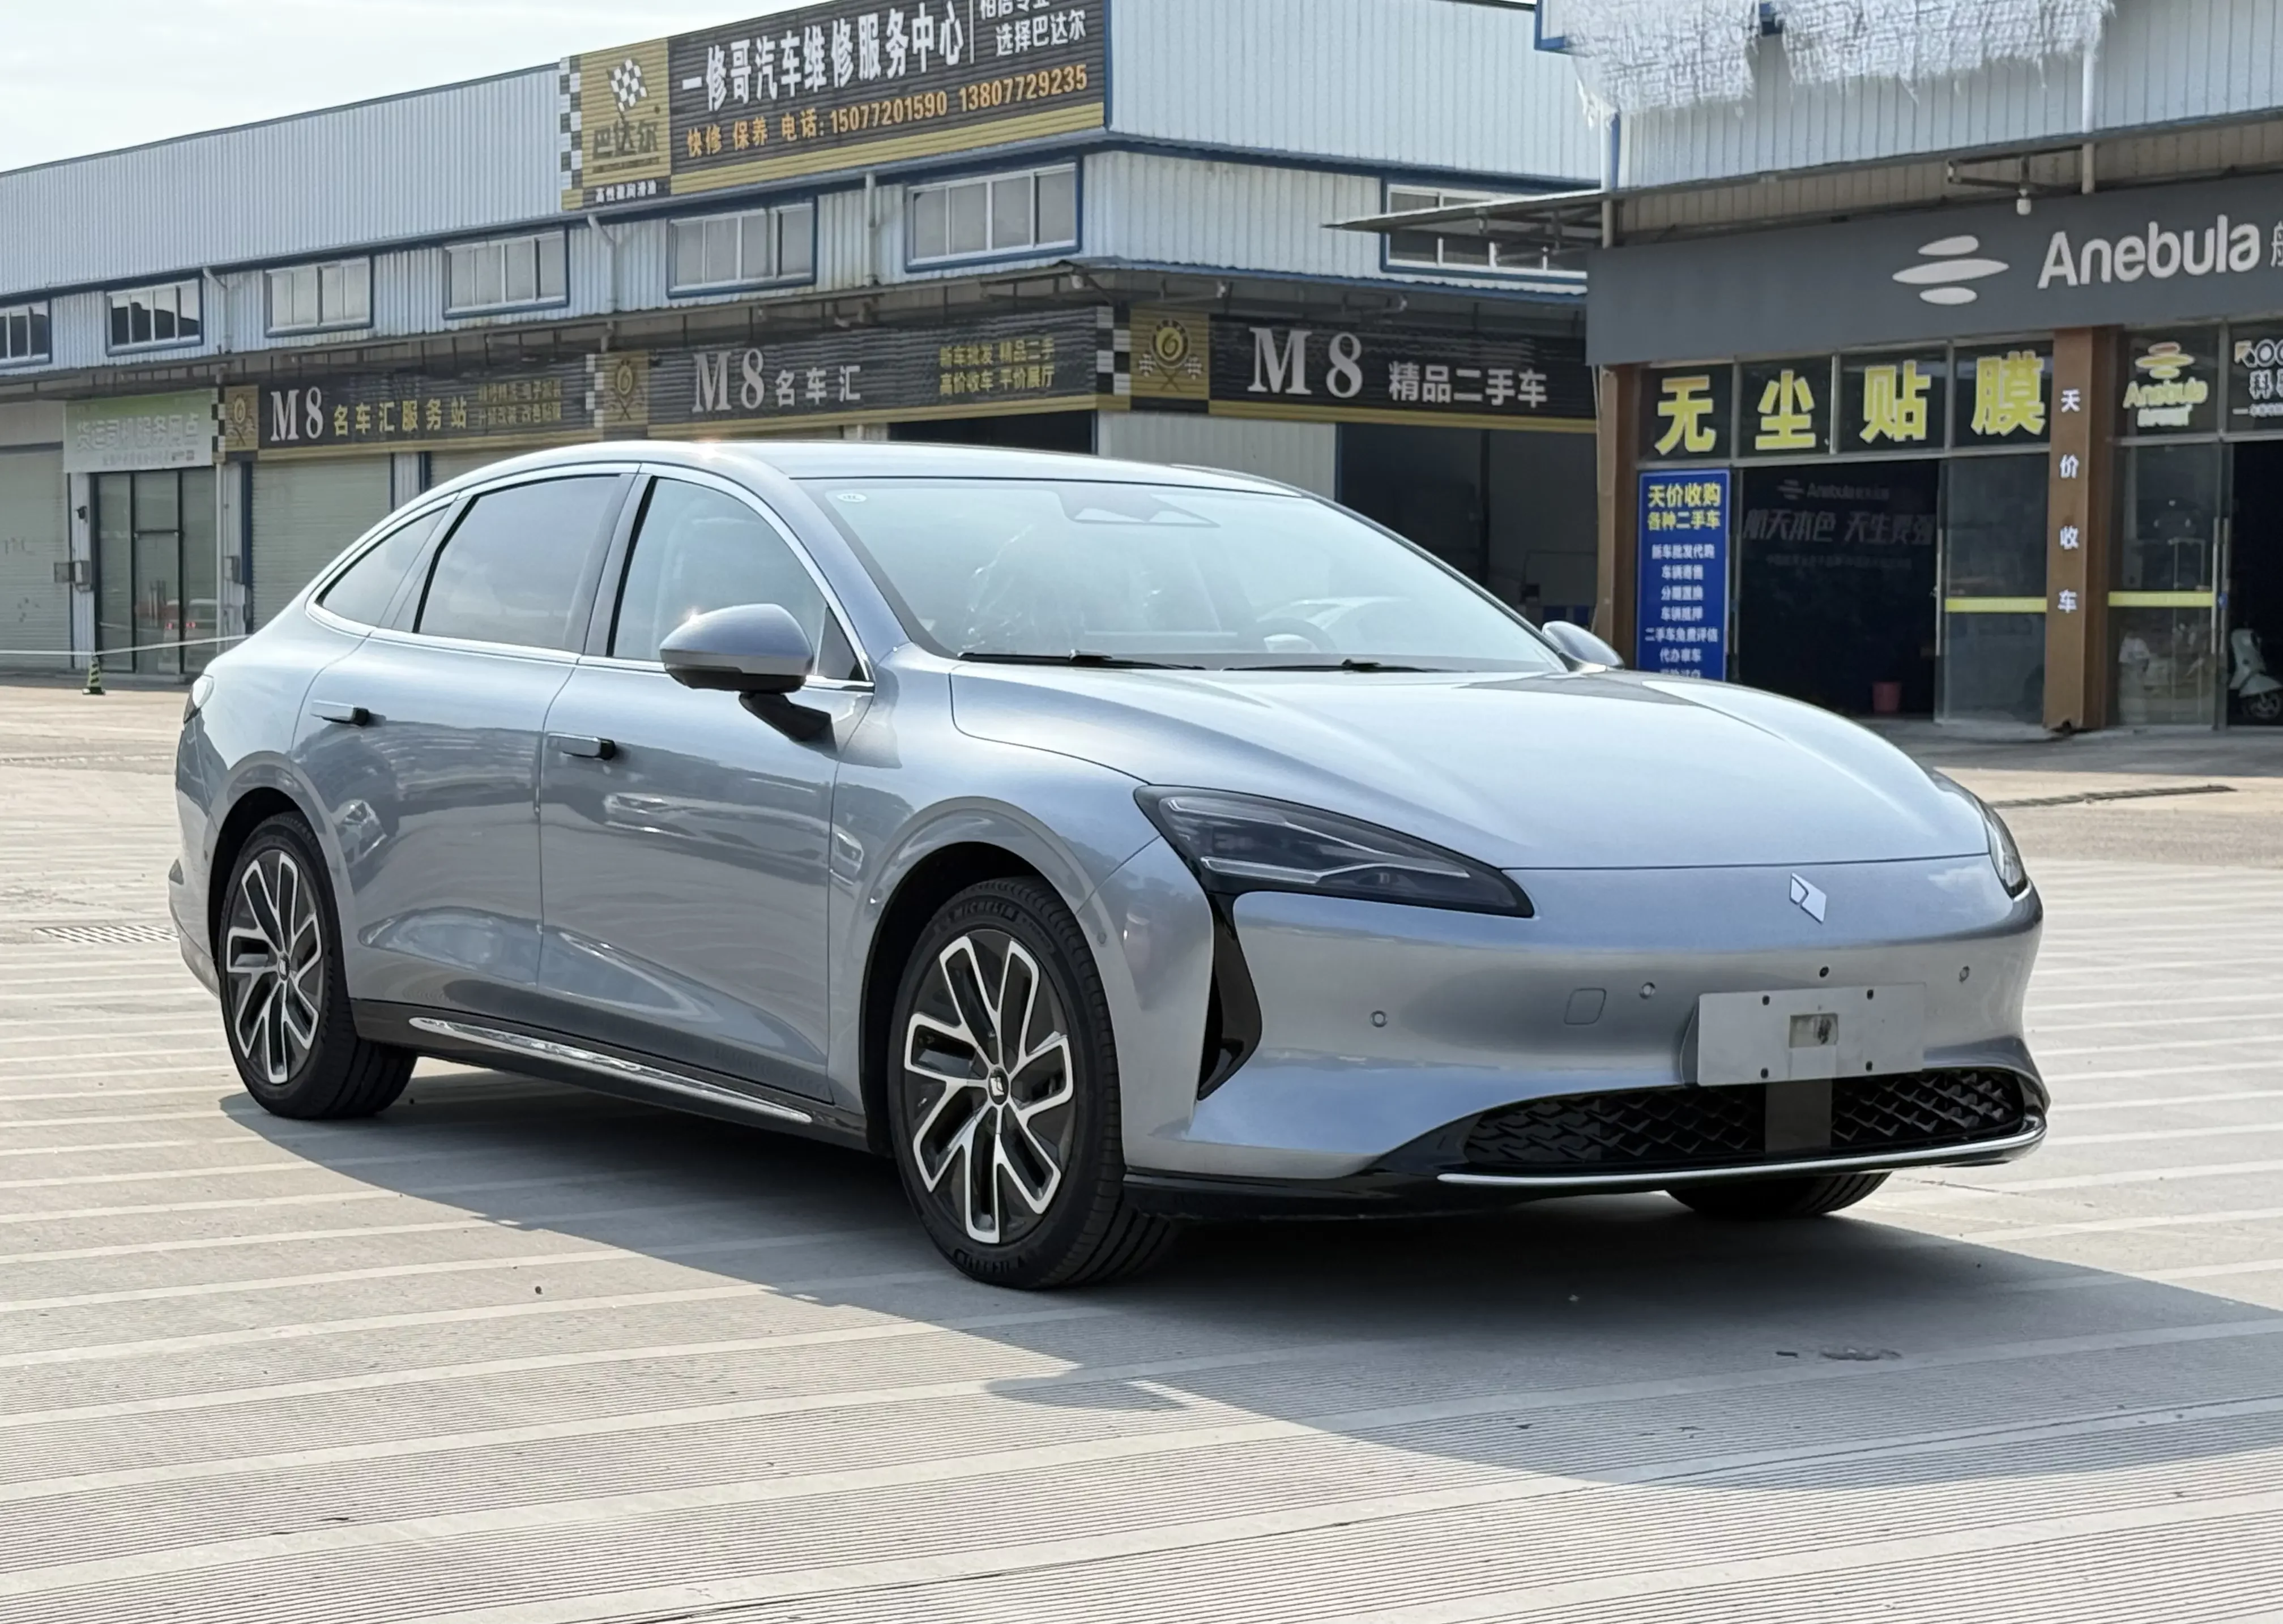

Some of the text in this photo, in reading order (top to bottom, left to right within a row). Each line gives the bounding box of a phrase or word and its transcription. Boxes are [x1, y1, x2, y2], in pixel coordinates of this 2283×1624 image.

[682, 0, 964, 112] 一修哥汽车维修服务中心
[995, 9, 1086, 57] 选择巴达尔
[593, 119, 659, 160] 巴达尔
[687, 123, 722, 158] 快修
[733, 116, 769, 151] 保养
[830, 90, 948, 134] 15077201590
[959, 63, 1088, 112] 13807729235
[2037, 214, 2261, 289] Anebula
[692, 348, 861, 413] M8 名车汇
[940, 369, 995, 396] 高价收车
[1247, 326, 1548, 409] M8 精品二手车
[270, 386, 467, 442] M8 名车汇服务站
[1654, 349, 2046, 455] 无尘贴膜
[1647, 510, 1721, 531] 各种二手车
[1648, 481, 1721, 508] 天价收购
